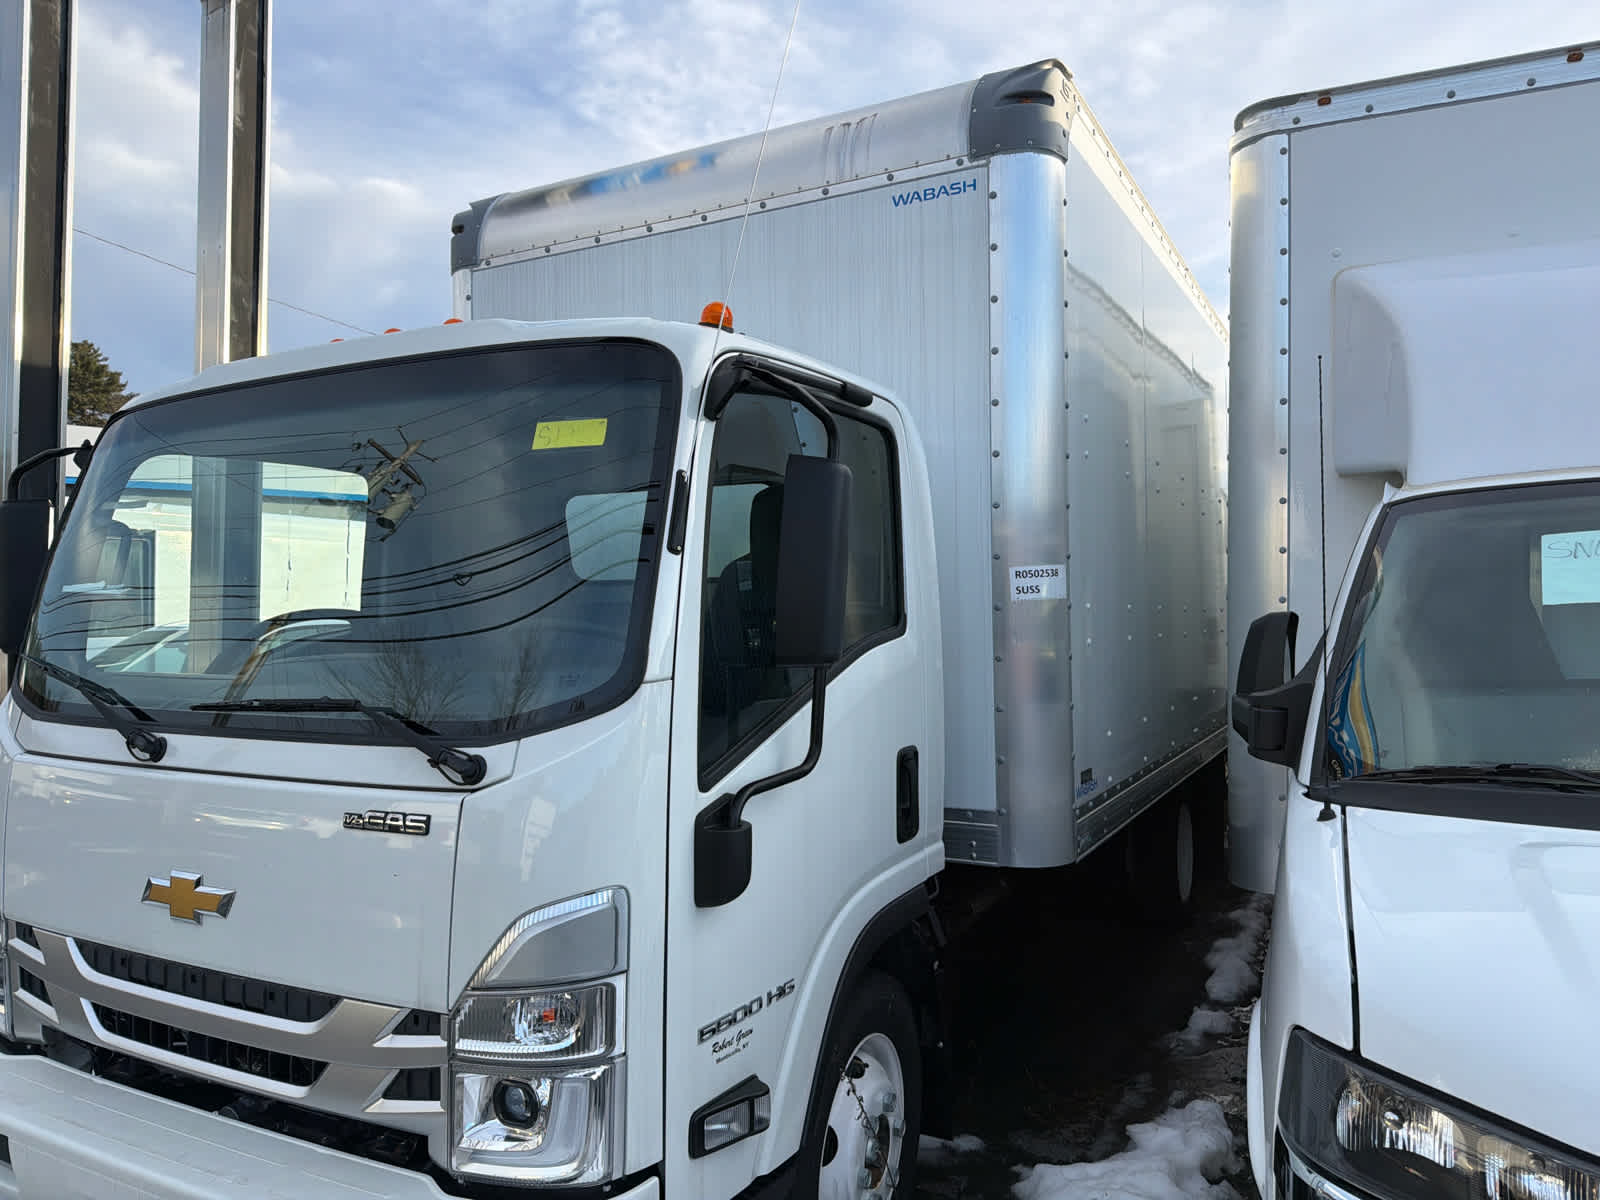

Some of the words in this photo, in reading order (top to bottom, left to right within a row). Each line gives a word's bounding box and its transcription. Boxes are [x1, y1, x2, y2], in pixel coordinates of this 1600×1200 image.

[892, 178, 977, 208] WABASH
[1015, 568, 1059, 579] R0502538
[1015, 584, 1041, 595] SUSS
[364, 811, 428, 834] GAS
